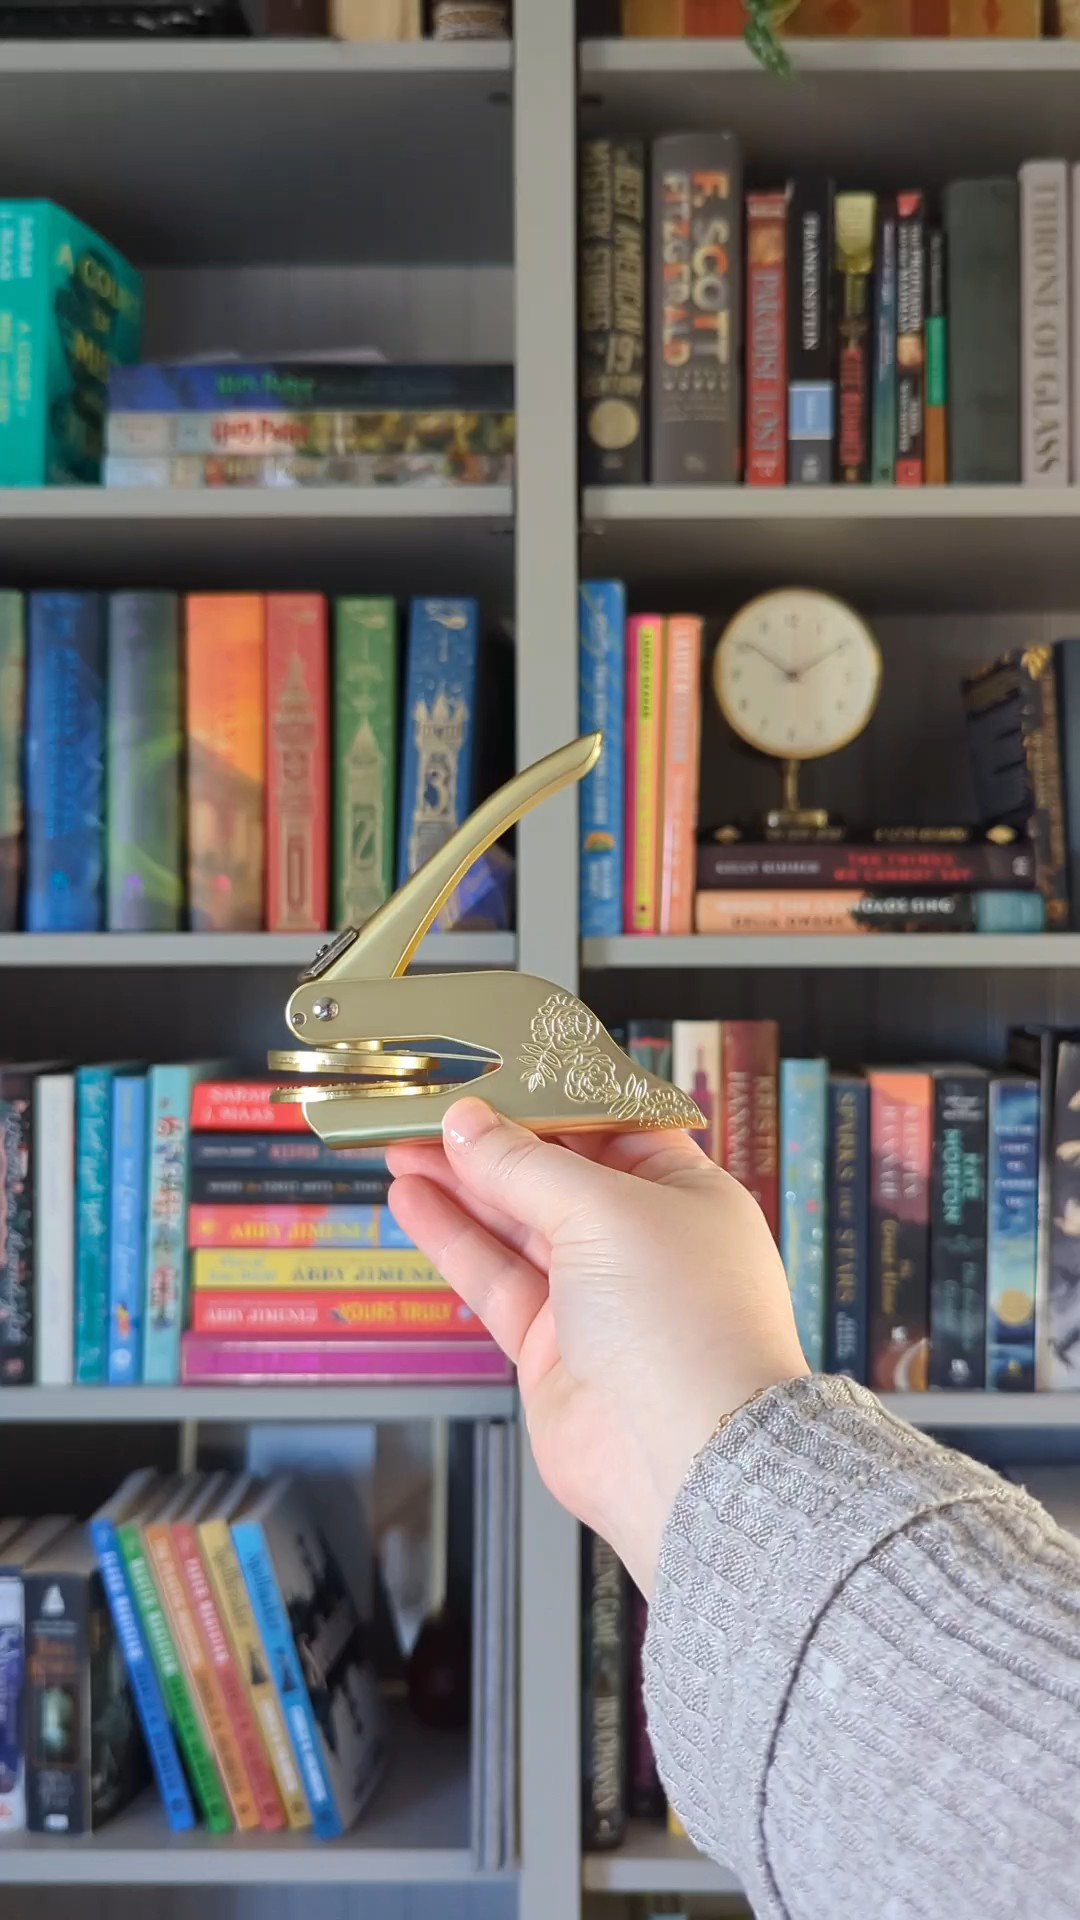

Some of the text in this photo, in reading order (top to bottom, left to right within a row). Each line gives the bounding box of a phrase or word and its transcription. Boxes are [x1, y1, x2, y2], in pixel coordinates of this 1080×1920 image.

[692, 171, 728, 207] F.
[662, 170, 690, 366] FITZGERALD
[692, 219, 729, 364] SCOTT
[802, 212, 819, 350] FRANKENSTEIN
[752, 271, 780, 450] PARADISE LOST
[1031, 182, 1060, 474] THRONE OF GLASS
[755, 1075, 777, 1175] KRISTIN
[836, 1091, 856, 1178] SPARKS
[880, 1105, 900, 1200] HANNAH
[942, 1128, 962, 1225] MORTON
[962, 1152, 980, 1200] KATE
[292, 1266, 345, 1281] ABBY
[355, 1266, 445, 1281] JIMENE
[836, 1228, 856, 1303] STARS
[592, 1598, 621, 1644] GAME
